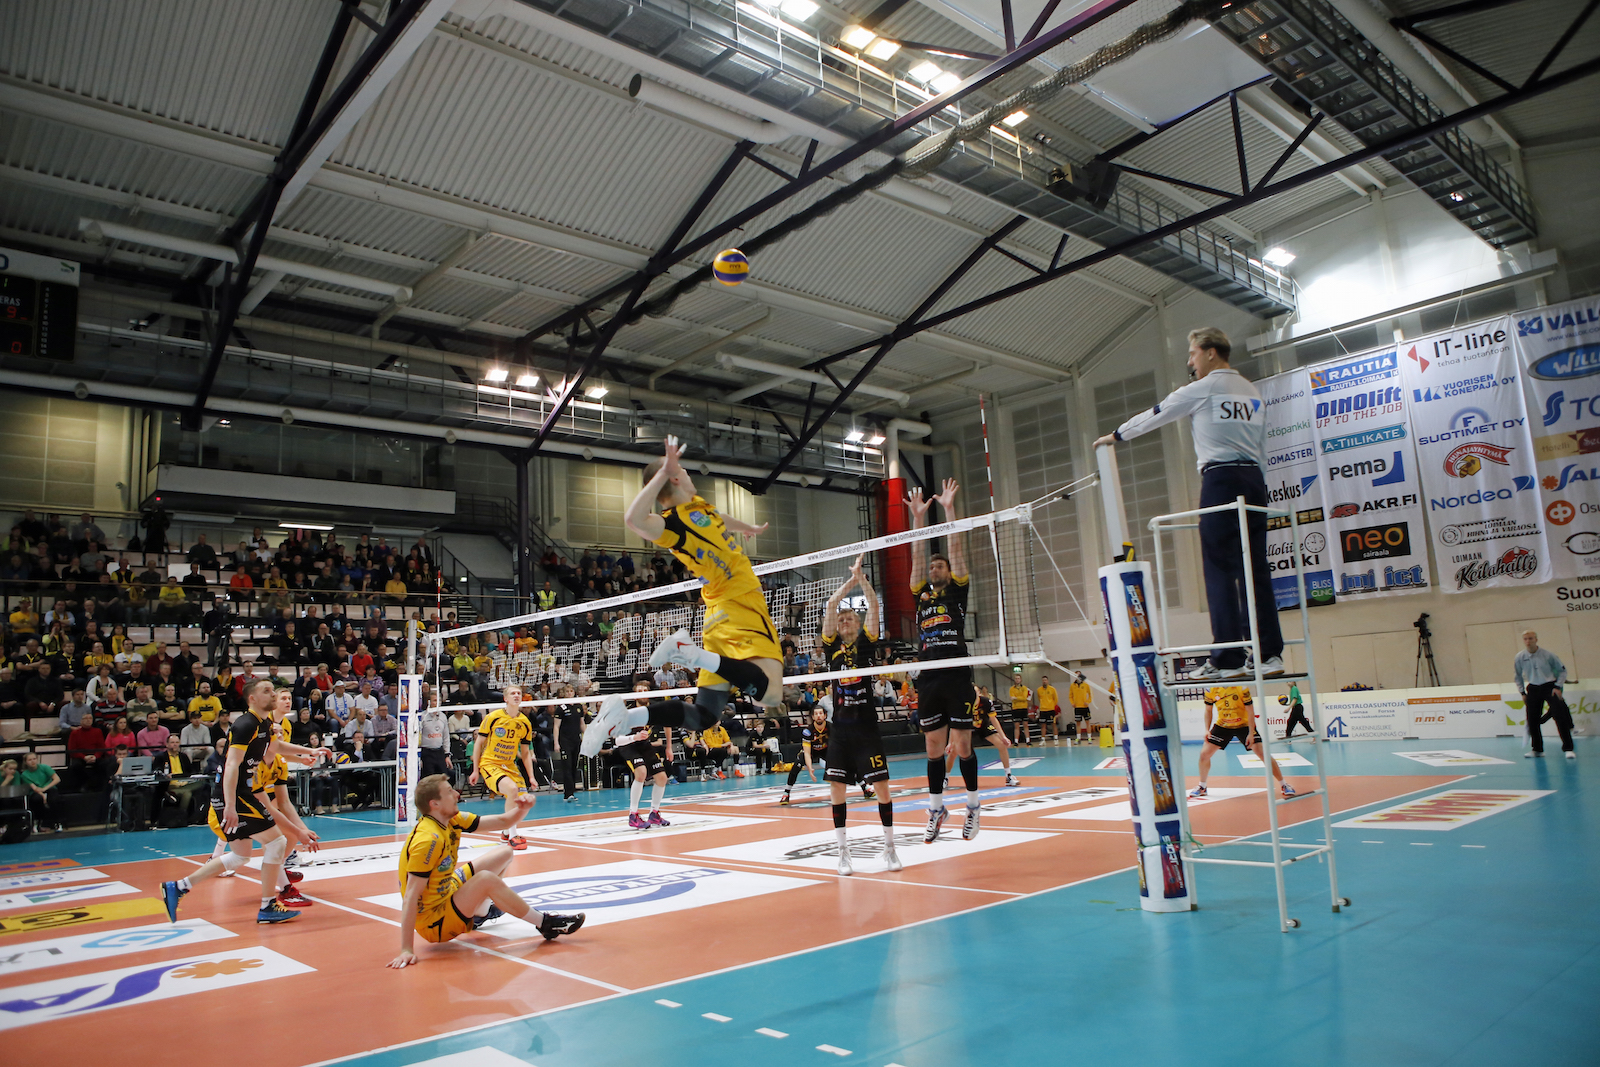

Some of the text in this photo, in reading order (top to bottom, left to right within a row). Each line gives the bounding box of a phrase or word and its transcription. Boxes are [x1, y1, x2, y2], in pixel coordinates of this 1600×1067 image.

[1547, 308, 1600, 331] VALL
[11, 341, 22, 354] 0
[1433, 329, 1507, 358] IT-line
[1328, 357, 1393, 380] RAUTIA
[1553, 352, 1600, 374] WILL
[1330, 373, 1386, 391] RAUTIA LOIMAA
[1443, 373, 1494, 390] VUORISEN
[1444, 376, 1516, 398] KONEPAJA OY
[1220, 401, 1253, 421] SRV
[1316, 402, 1402, 428] UP TO THE JOB
[1325, 428, 1400, 450] A-TIILIKATE
[1418, 417, 1526, 445] SUOTIMET OY
[1448, 443, 1502, 463] HUNAJAYHTYMÄ
[1362, 493, 1417, 512] AKR.FI
[1431, 488, 1513, 511] Nordea
[885, 522, 956, 544] www.loimaanseurahuone.fi
[1345, 527, 1404, 552] neo
[1363, 549, 1390, 558] sairaala
[1452, 552, 1482, 563] LOIMAAN
[1455, 554, 1538, 591] Keilahalli
[1311, 579, 1332, 589] BLISS
[1126, 585, 1145, 615] SPORT
[1138, 666, 1157, 698] SPORT
[1325, 701, 1406, 710] KERROSTALOASUNTOJA
[1414, 715, 1445, 723] nmc
[506, 729, 515, 739] 13
[870, 755, 884, 769] 15
[1150, 750, 1169, 782] SPORT
